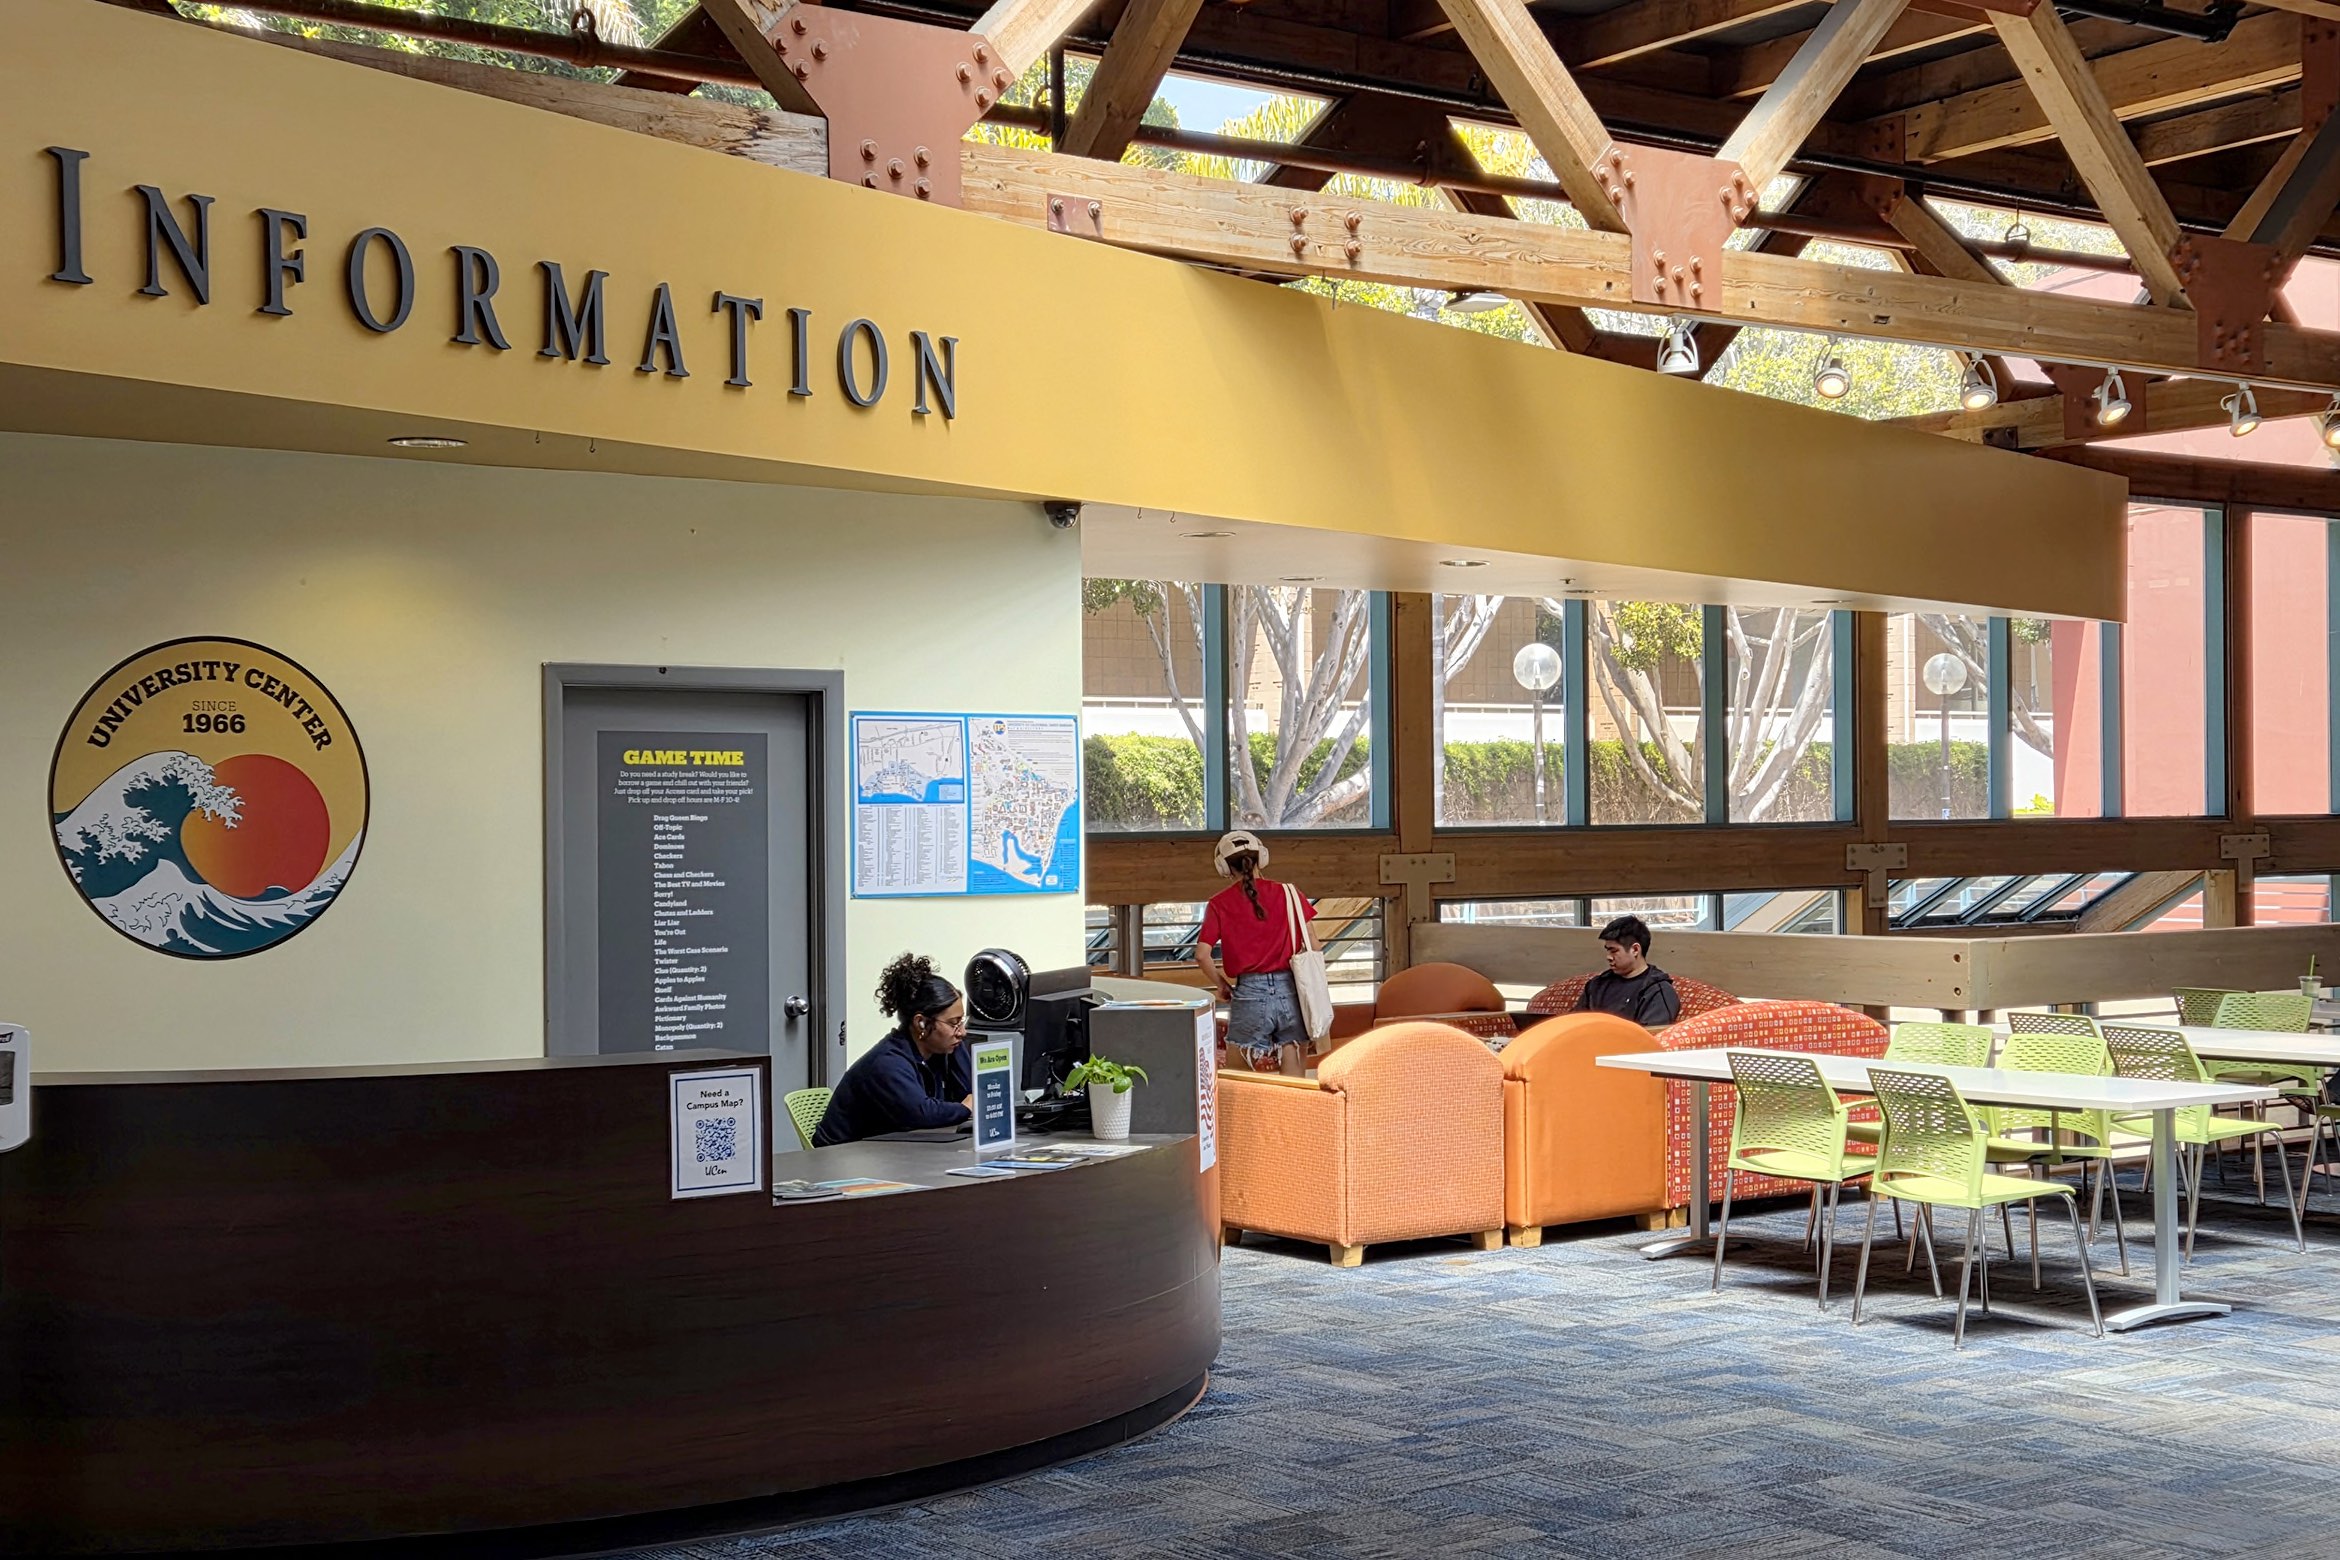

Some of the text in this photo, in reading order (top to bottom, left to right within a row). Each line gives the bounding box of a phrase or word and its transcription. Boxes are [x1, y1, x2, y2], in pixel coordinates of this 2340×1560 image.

[44, 146, 958, 420] INFORMATION
[87, 661, 332, 751] UNIVERSITY CENTER
[192, 700, 237, 712] SINCE
[182, 713, 246, 734] 1966
[623, 750, 744, 766] GAME TIME
[620, 770, 629, 778] Do
[690, 814, 708, 822] Bingo
[674, 995, 696, 1003] Against
[655, 1024, 685, 1032] Monopoly
[700, 1089, 722, 1098] Need
[687, 1099, 744, 1110] Campus Map?
